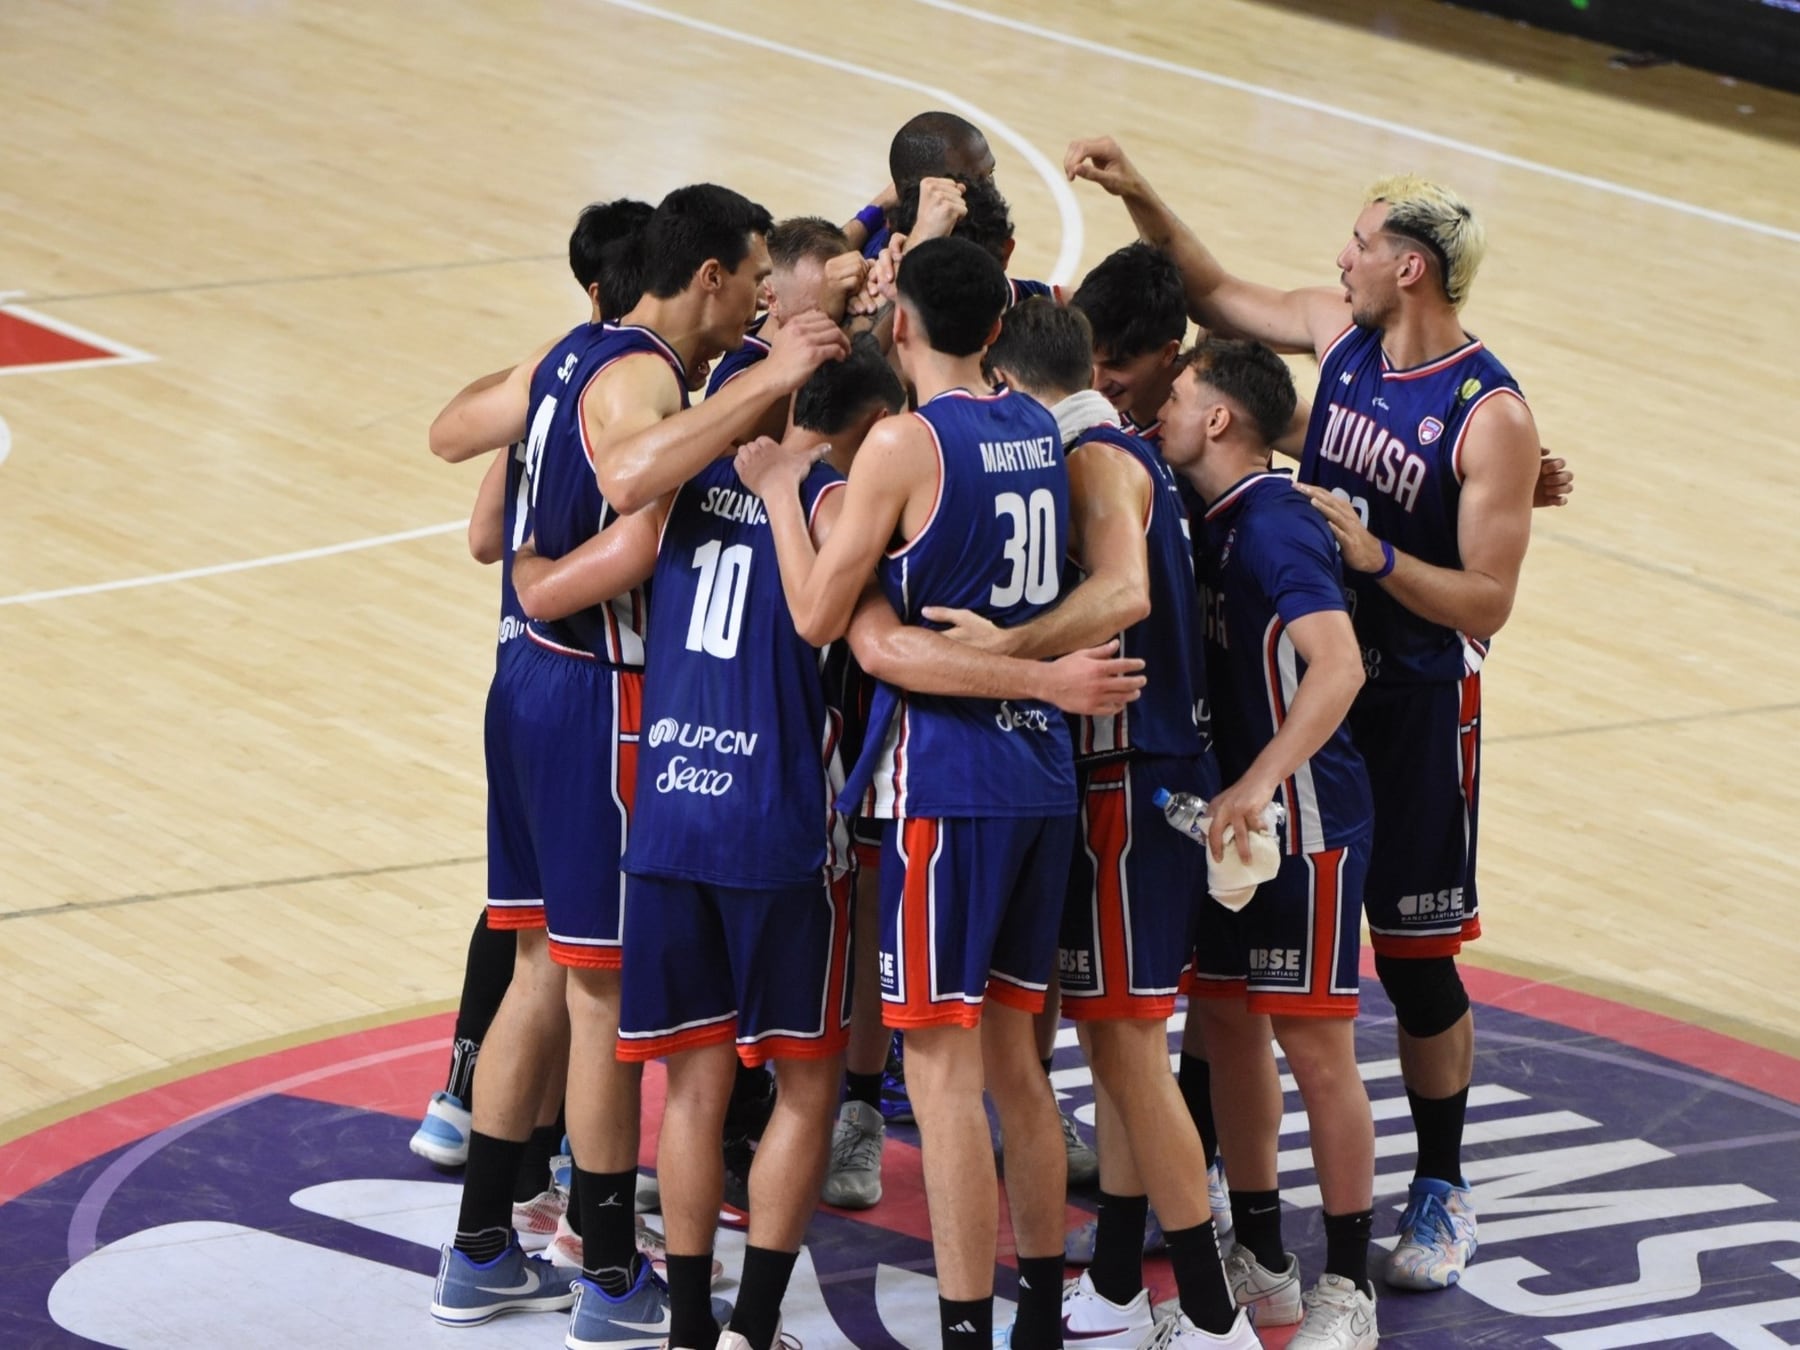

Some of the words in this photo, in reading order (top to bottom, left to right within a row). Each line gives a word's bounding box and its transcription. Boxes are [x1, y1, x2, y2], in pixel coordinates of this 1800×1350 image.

[979, 436, 1057, 473] MARTINEZ
[989, 488, 1060, 608] 30
[685, 539, 753, 660] 10
[678, 723, 758, 756] UPCN
[656, 755, 733, 796] Secco
[1419, 887, 1464, 914] BSE
[1059, 948, 1090, 973] BSE
[1258, 948, 1301, 970] BSE
